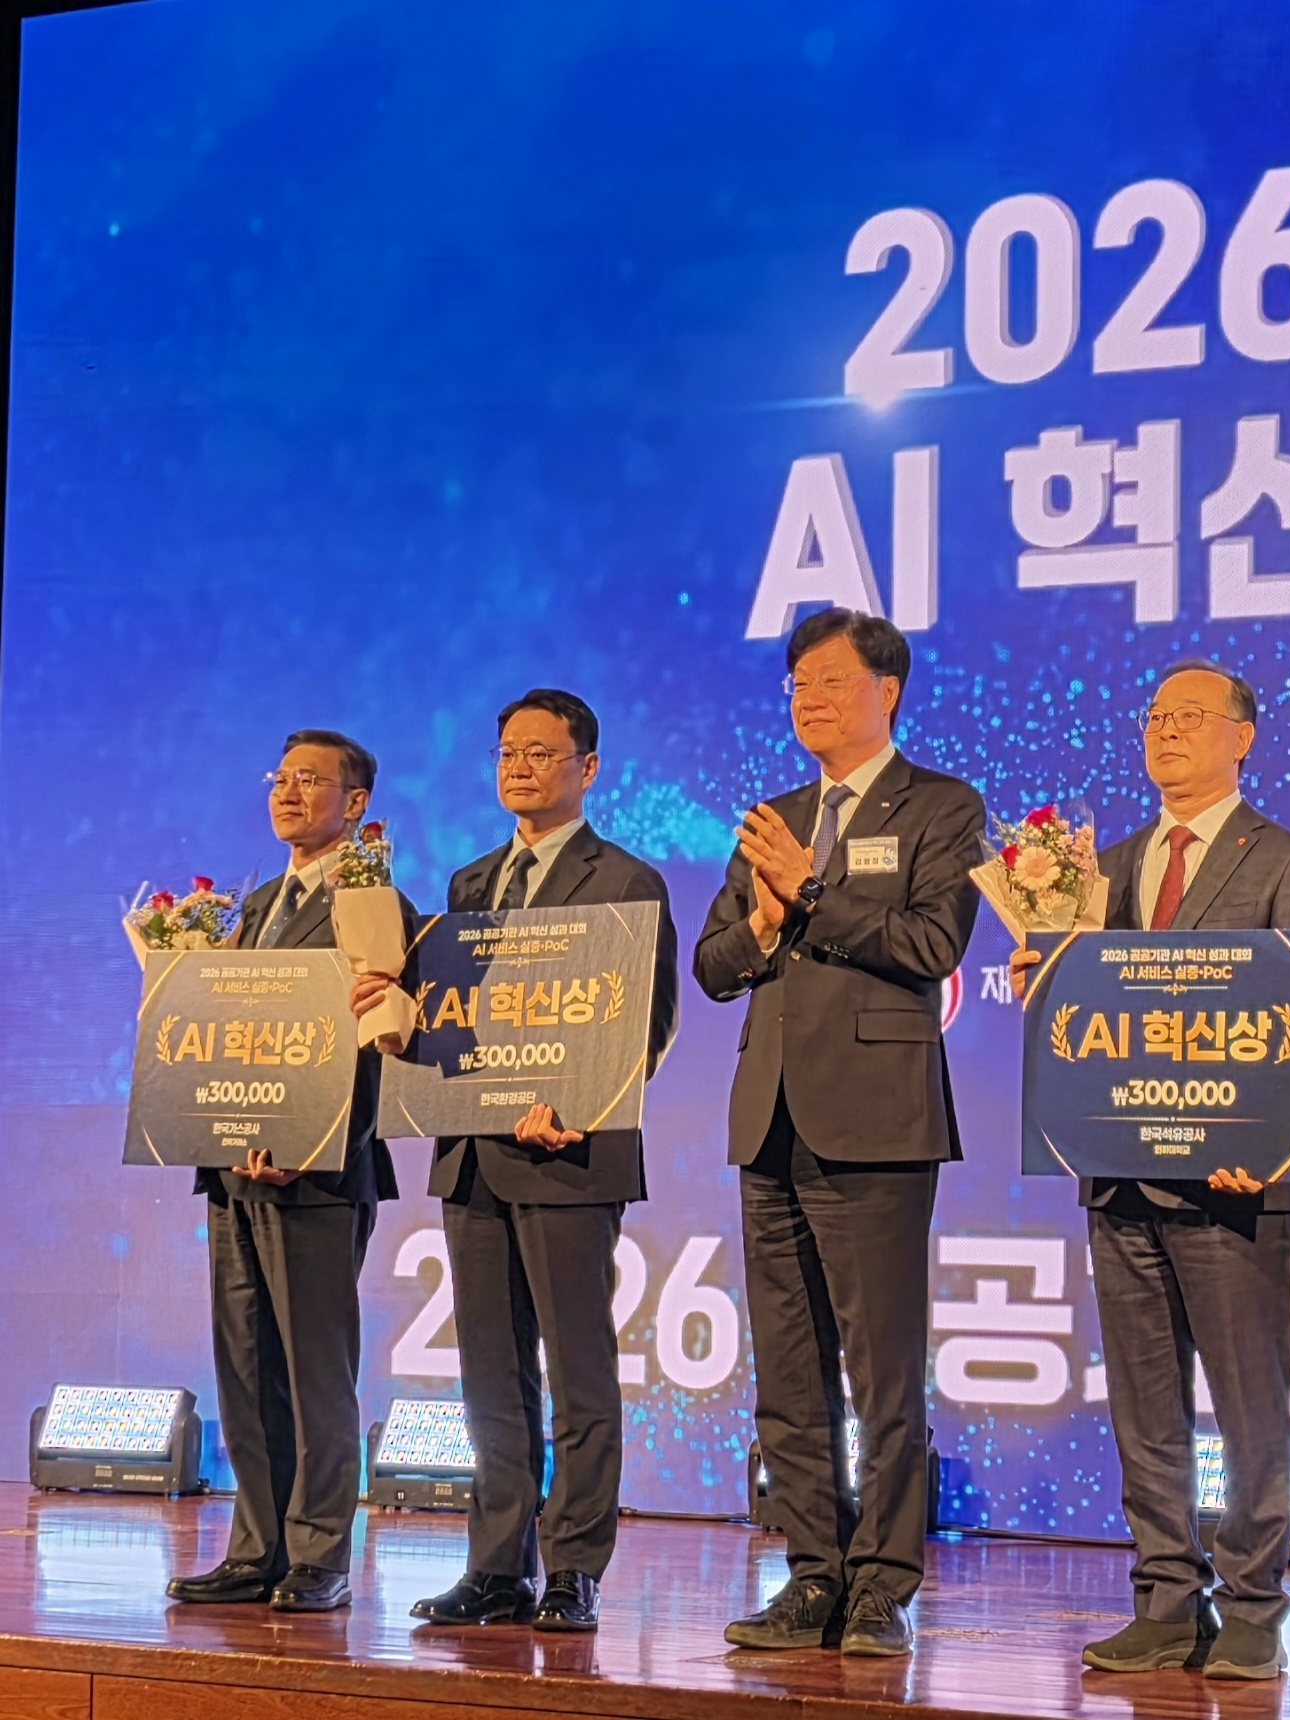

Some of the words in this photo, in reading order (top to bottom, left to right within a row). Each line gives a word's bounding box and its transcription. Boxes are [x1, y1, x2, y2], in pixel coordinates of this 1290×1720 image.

[744, 444, 940, 641] AI
[1101, 950, 1128, 962] 2026
[1130, 949, 1170, 962] 공공기관
[1172, 949, 1184, 961] AI
[1185, 949, 1206, 962] 혁신
[1209, 949, 1229, 961] 성과
[1119, 967, 1134, 979] AI
[1137, 966, 1172, 980] 서비스
[431, 987, 479, 1029] AI
[490, 978, 600, 1027] 혁신상
[174, 1023, 216, 1062] AI
[224, 1021, 316, 1065] 혁신상
[1077, 1013, 1130, 1058] AI
[1142, 1010, 1273, 1062] 혁신상
[459, 1042, 566, 1070] ₩300,000
[196, 1081, 285, 1107] ₩300,000
[480, 1091, 536, 1106] 한국환경공단
[1112, 1080, 1236, 1110] ₩300,000
[213, 1122, 260, 1135] 한국가스공사
[1140, 1126, 1206, 1142] 한국석유공사
[391, 1229, 738, 1389] 26
